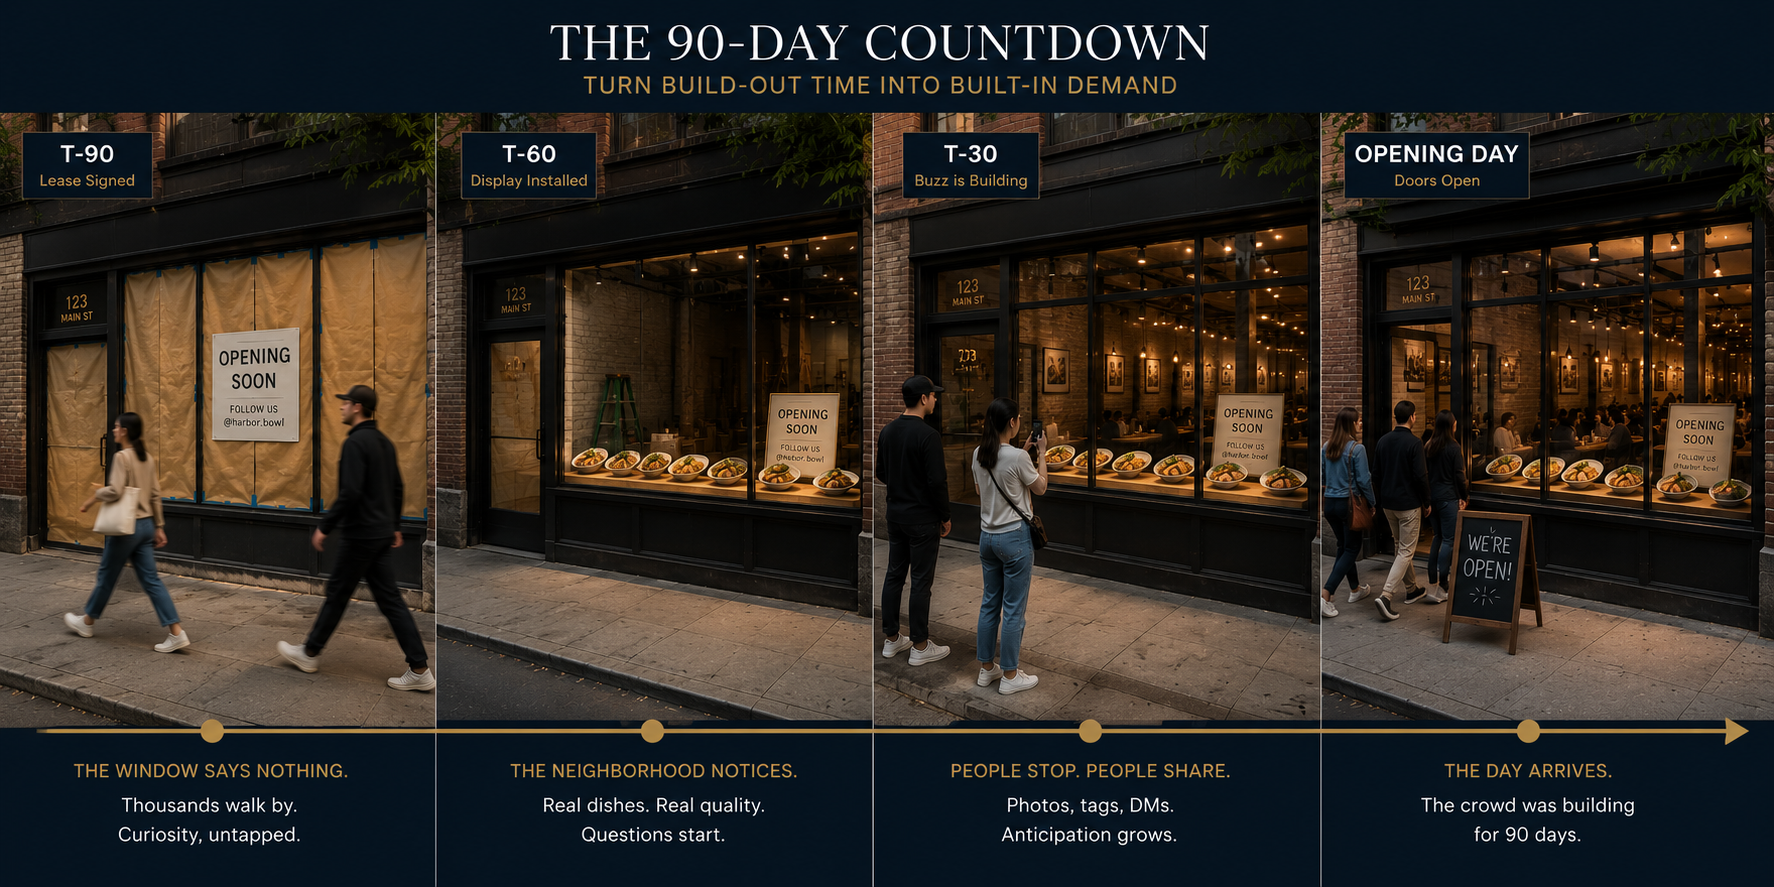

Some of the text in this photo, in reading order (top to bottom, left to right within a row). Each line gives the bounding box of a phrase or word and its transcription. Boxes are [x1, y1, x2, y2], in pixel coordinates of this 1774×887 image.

[957, 278, 979, 294] 123
[1406, 274, 1430, 291] 123
[505, 286, 527, 302] 123
[952, 295, 985, 306] MAIN ST
[1402, 292, 1436, 304] MAIN ST
[65, 293, 88, 310] 123
[501, 302, 532, 314] MAIN ST
[60, 310, 94, 324] MAIN ST
[219, 347, 291, 366] OPENING
[231, 372, 276, 390] SOON
[229, 404, 279, 414] FOLLOW US
[777, 408, 829, 420] OPENING
[1223, 407, 1274, 420] OPENING
[223, 417, 285, 428] @harbor.bowl
[786, 423, 818, 435] SOON
[1231, 422, 1263, 434] SOON
[1675, 418, 1726, 432] OPENING
[1683, 433, 1715, 446] SOON
[780, 443, 821, 453] FOLLOW US
[1468, 533, 1513, 555] WE'RE
[1463, 557, 1513, 582] OPEN!
